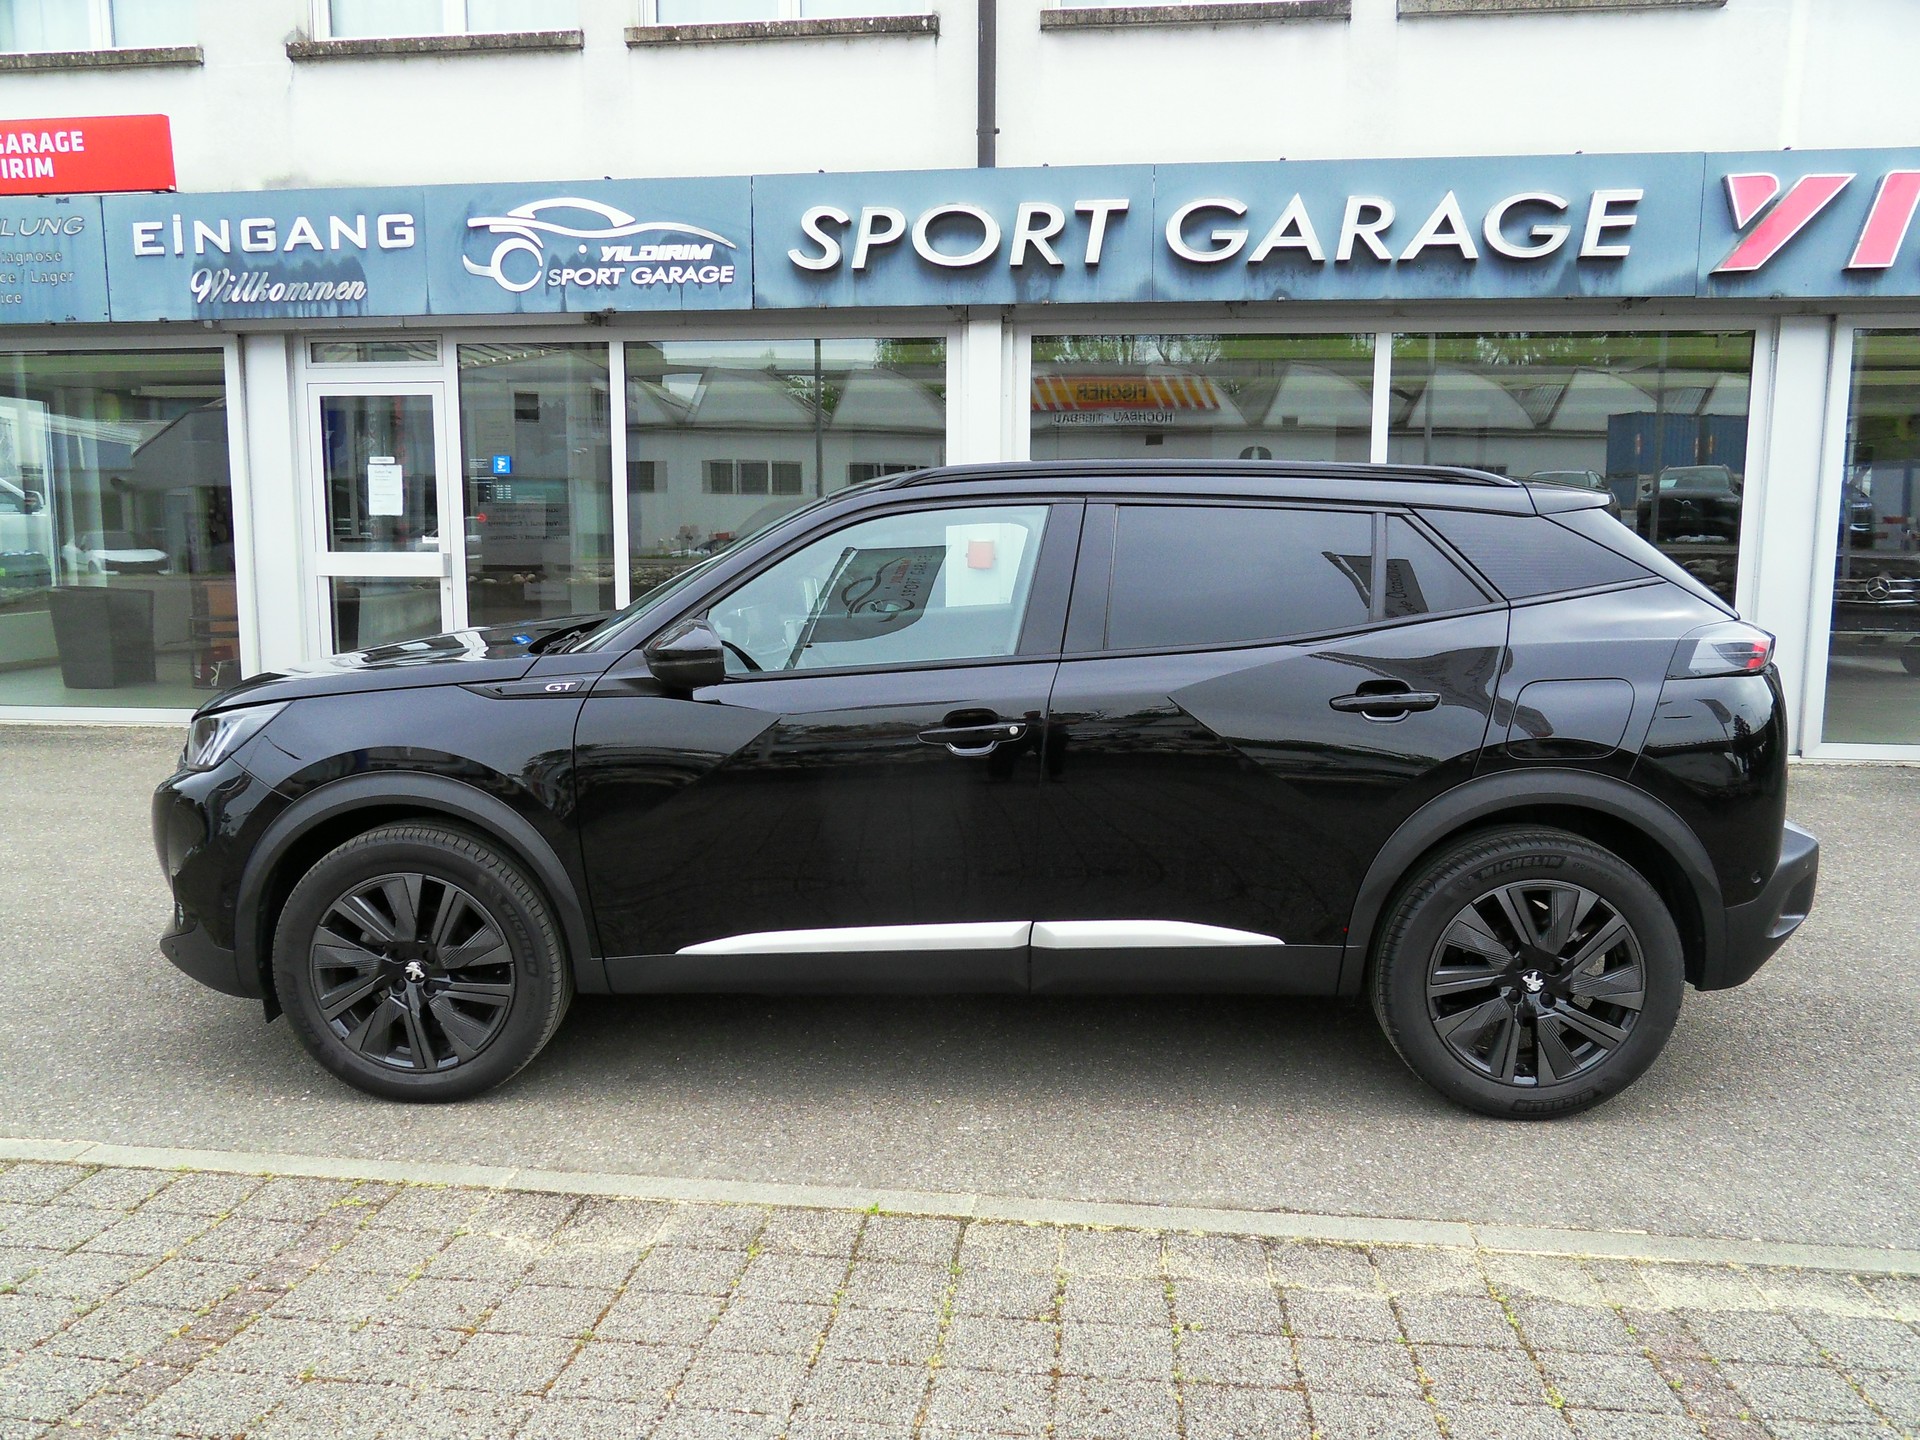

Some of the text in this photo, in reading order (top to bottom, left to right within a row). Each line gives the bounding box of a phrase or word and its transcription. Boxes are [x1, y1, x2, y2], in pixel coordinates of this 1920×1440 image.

[787, 198, 1130, 271] SPORT
[1165, 189, 1644, 263] GARAGE
[600, 243, 714, 262] YILDIRIM
[30, 270, 76, 287] Lager
[190, 267, 367, 304] Willkommen
[547, 265, 735, 286] SPORT GARAGE
[545, 682, 576, 692] GT
